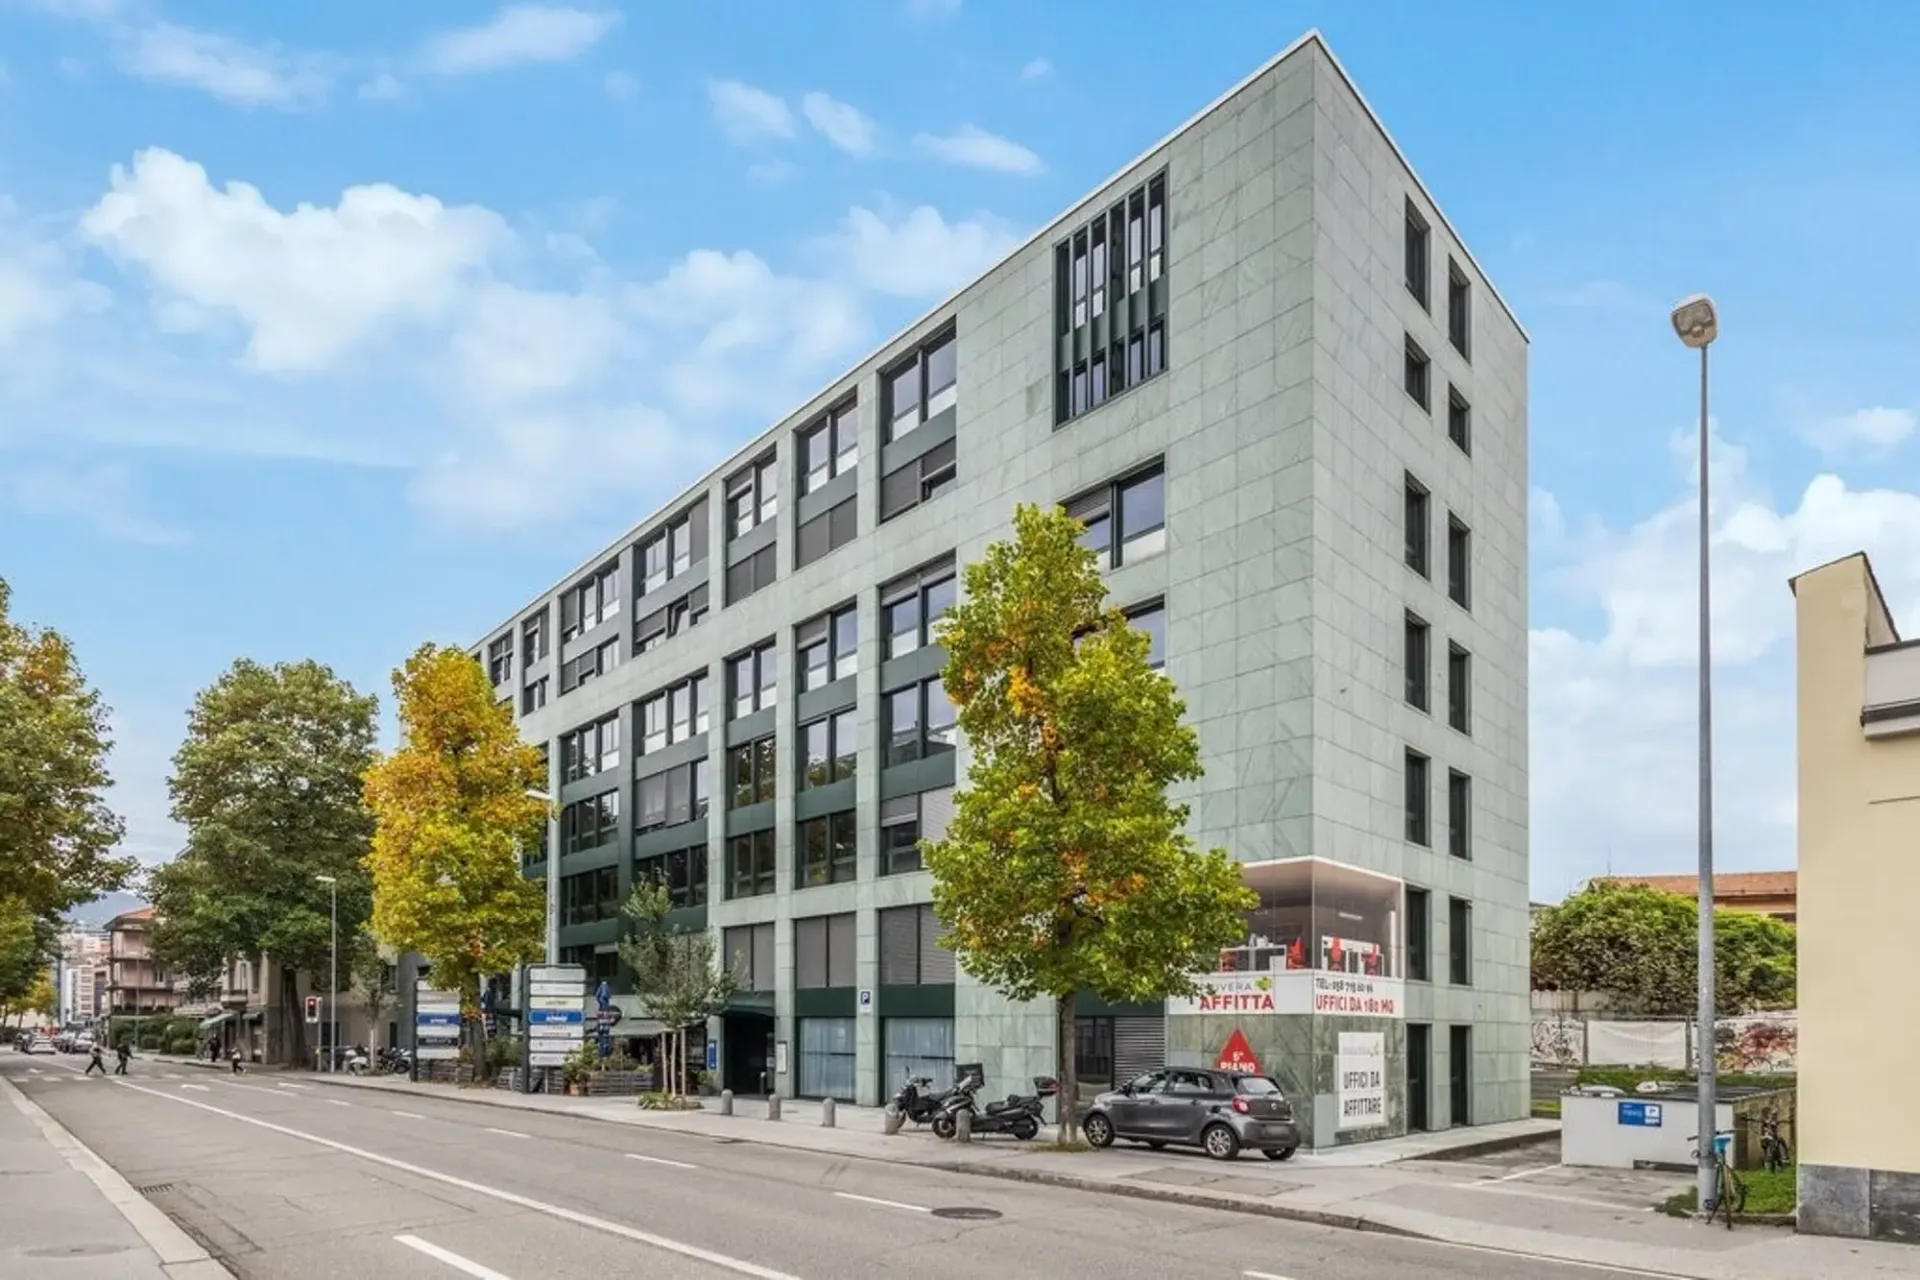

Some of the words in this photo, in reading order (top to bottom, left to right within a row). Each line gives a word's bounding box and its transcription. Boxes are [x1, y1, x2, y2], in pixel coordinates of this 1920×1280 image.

[1199, 994, 1274, 1010] AFFITTA
[1315, 994, 1347, 1011] UFFICI
[1349, 997, 1361, 1012] DA
[1363, 999, 1378, 1013] 180
[1343, 1071, 1368, 1089] UFFICI
[1370, 1071, 1380, 1088] DA
[1343, 1096, 1382, 1116] AFFITTARE
